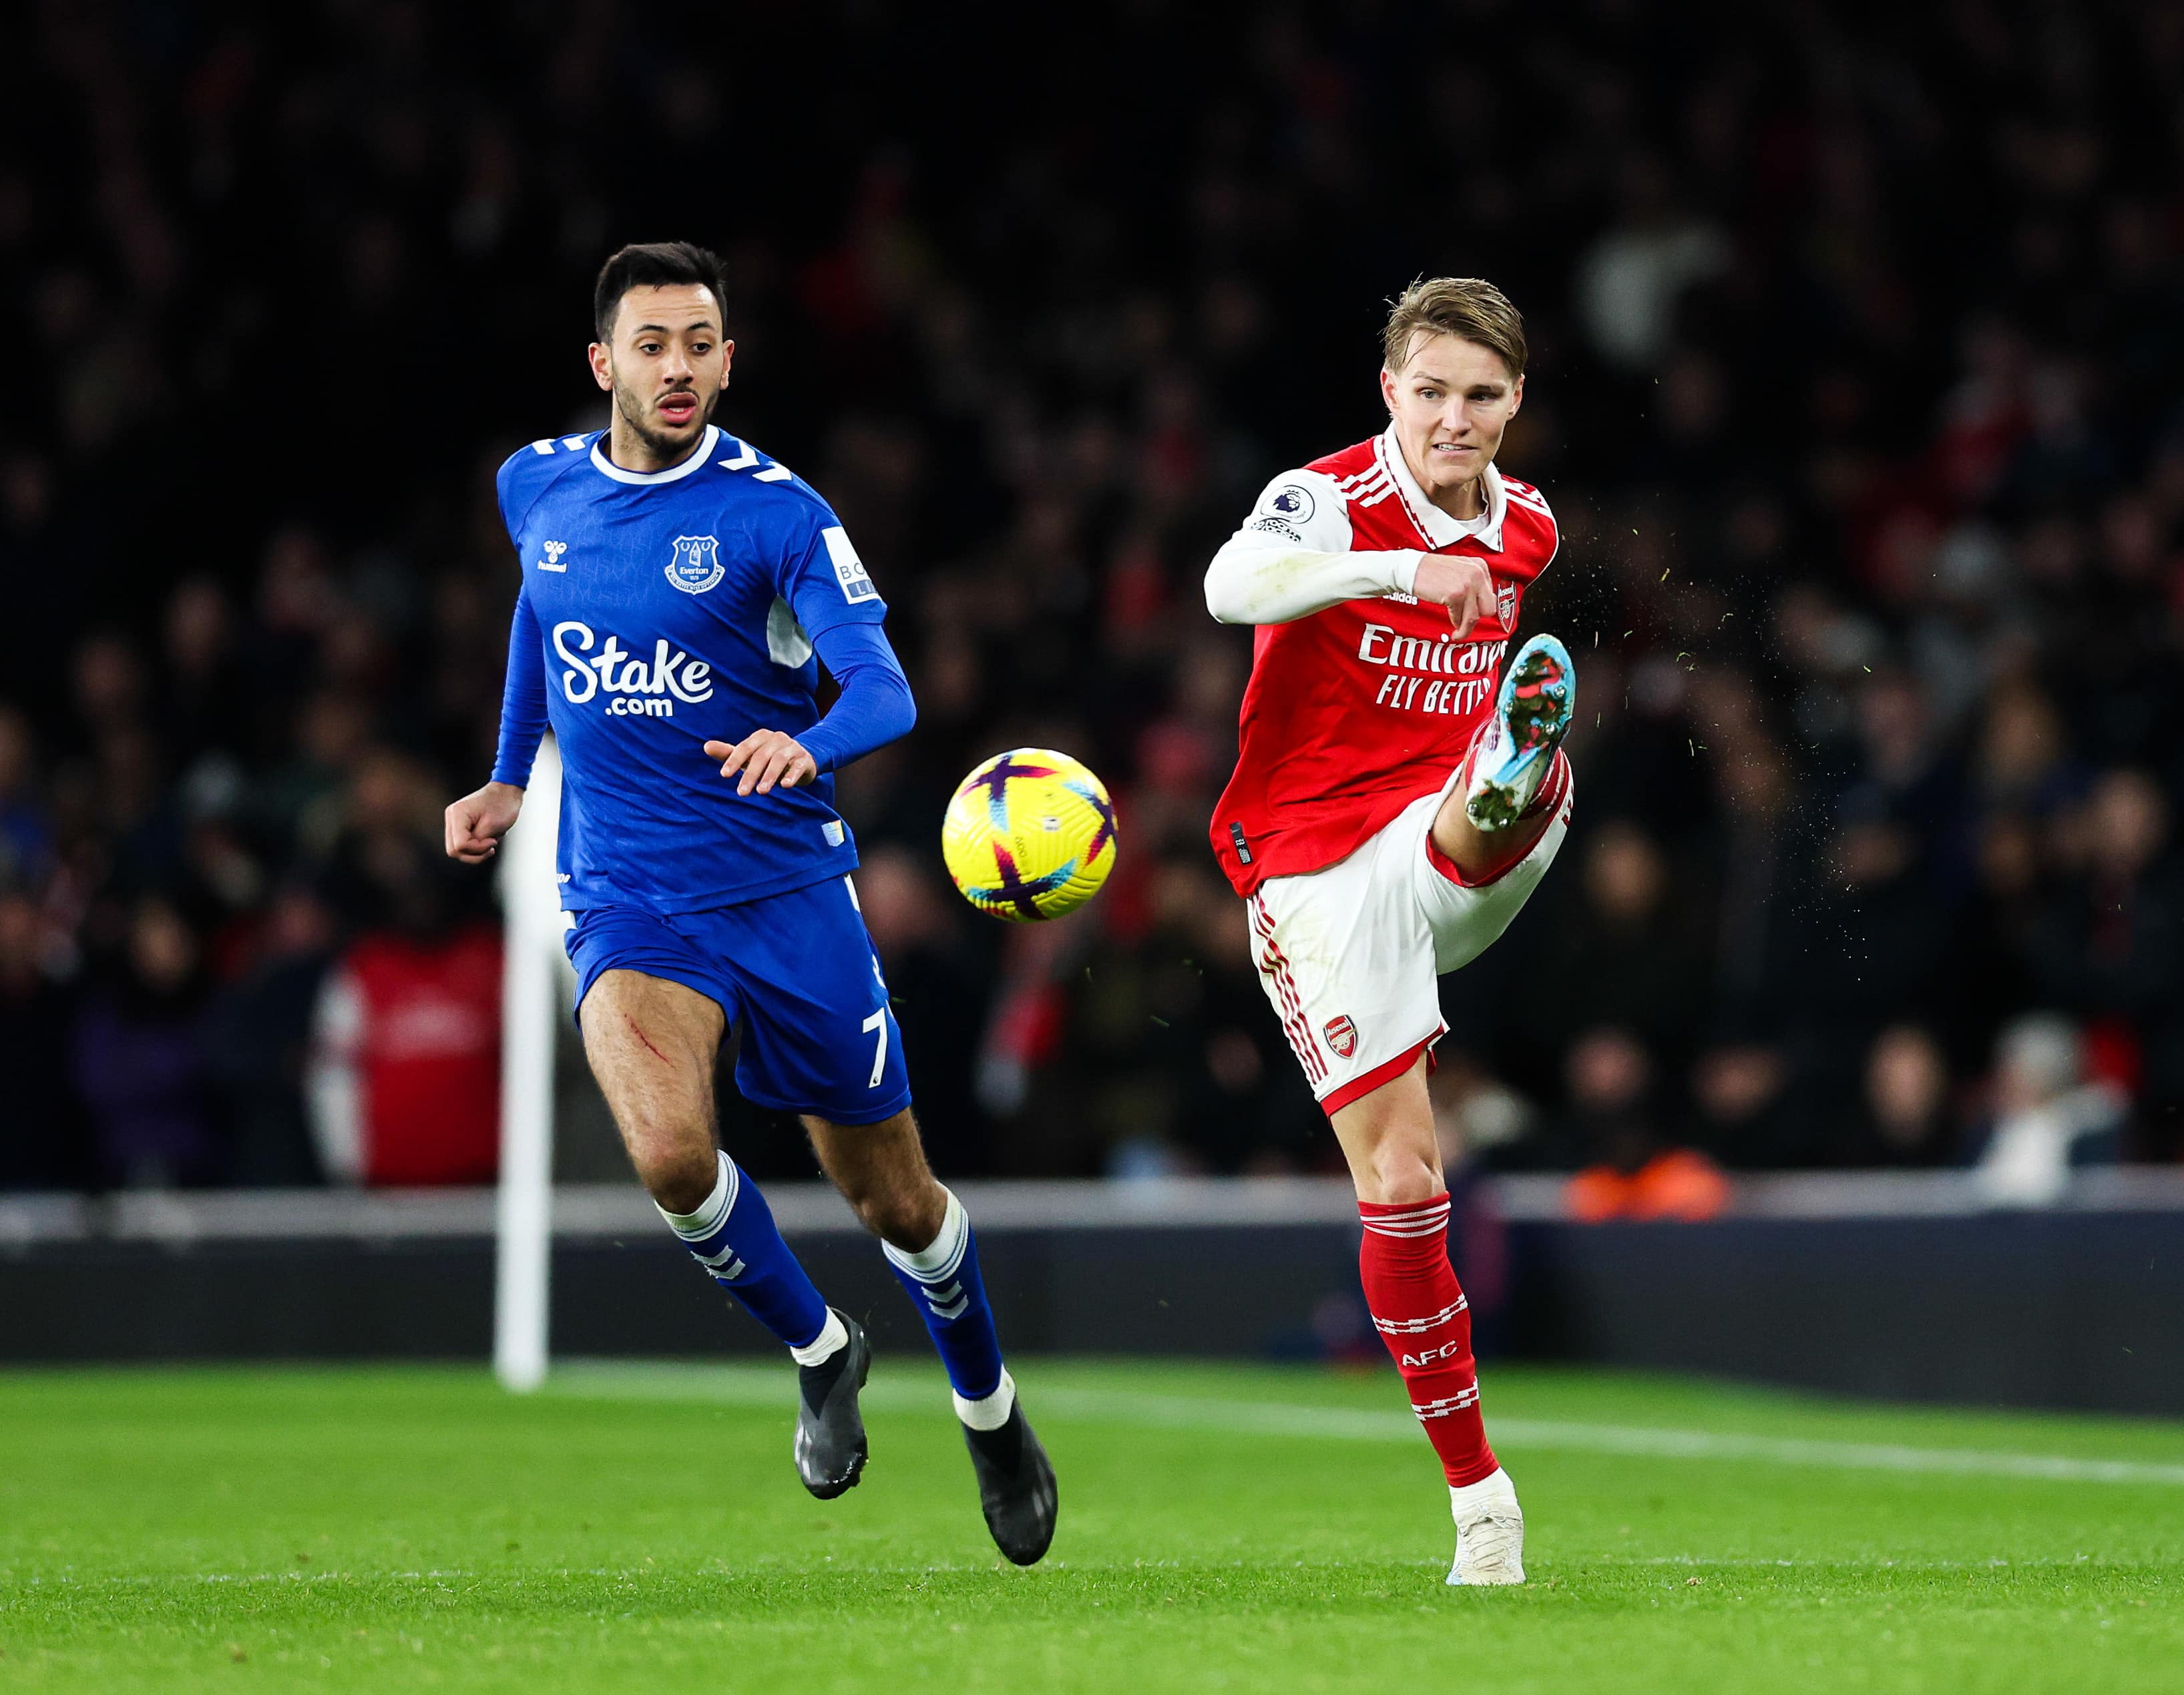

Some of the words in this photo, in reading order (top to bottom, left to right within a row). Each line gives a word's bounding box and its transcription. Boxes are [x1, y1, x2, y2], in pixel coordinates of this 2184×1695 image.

[537, 560, 567, 573] hummel
[680, 566, 708, 574] Everton
[552, 620, 714, 704] Stake
[1375, 674, 1424, 710] FLY
[605, 697, 673, 717] .com
[1327, 1019, 1350, 1036] Arsenal
[862, 1006, 888, 1089] 7
[1402, 1340, 1458, 1367] AFC
